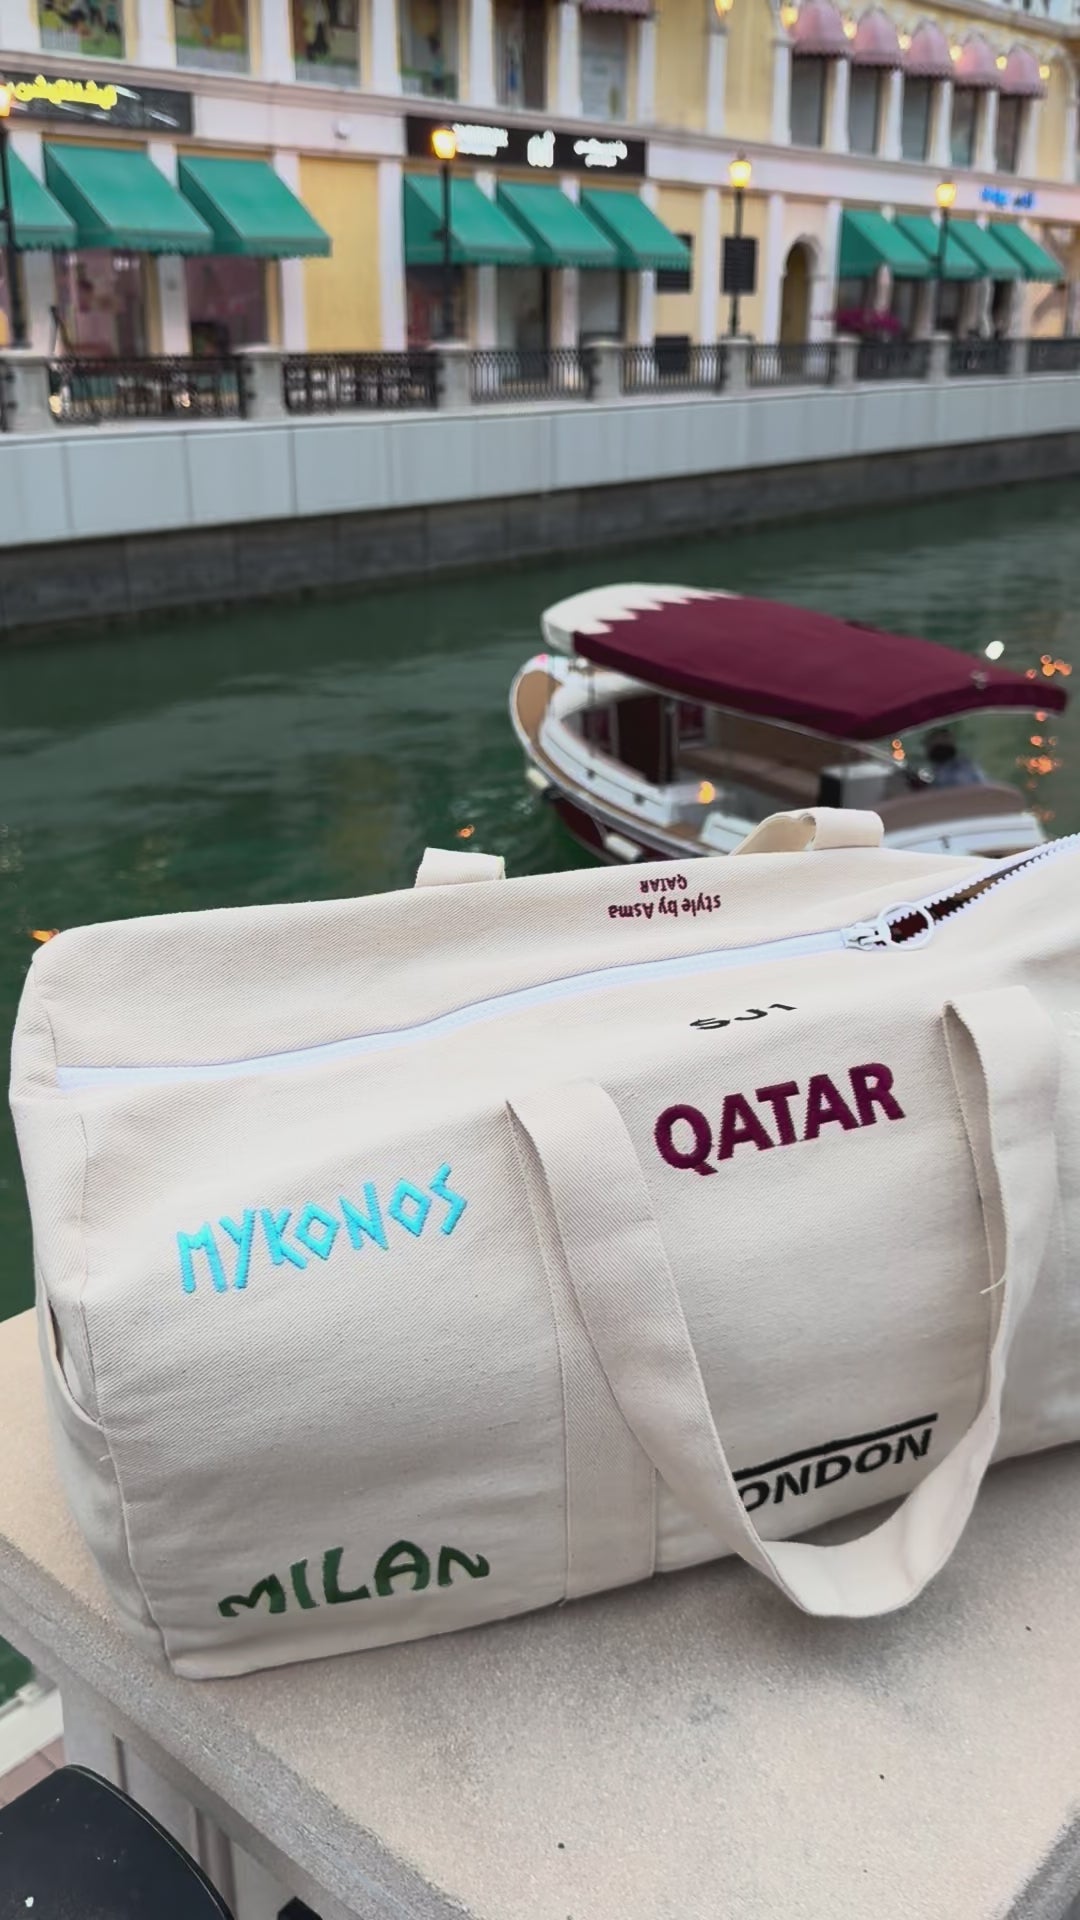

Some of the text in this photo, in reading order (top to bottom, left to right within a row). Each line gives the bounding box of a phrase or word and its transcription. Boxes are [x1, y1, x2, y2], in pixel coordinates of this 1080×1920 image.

[608, 893, 721, 919] style by Asma
[640, 874, 687, 893] QATAR
[654, 1062, 906, 1177] QATAR
[177, 1162, 468, 1294] MYKONOS
[739, 1428, 933, 1512] ONDON
[217, 1539, 491, 1617] MILAN
